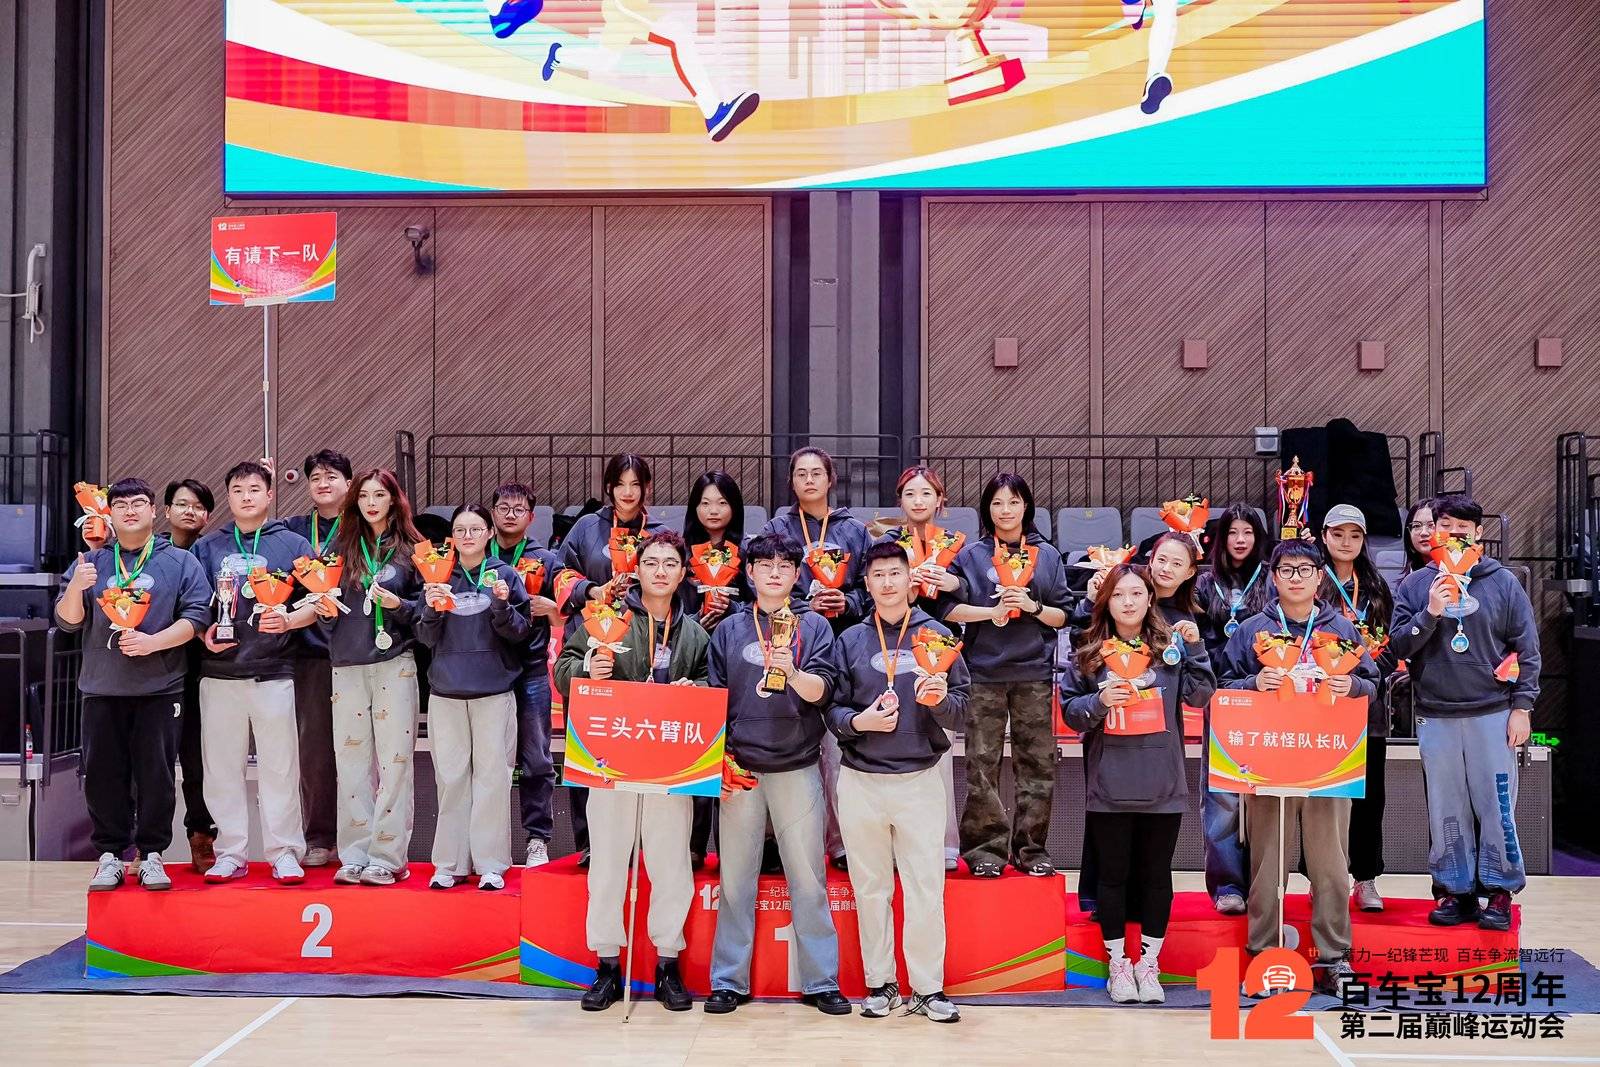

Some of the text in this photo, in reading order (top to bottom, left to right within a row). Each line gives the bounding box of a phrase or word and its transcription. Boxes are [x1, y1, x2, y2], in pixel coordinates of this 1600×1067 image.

[225, 243, 319, 265] 有请下一队
[577, 684, 589, 695] 12
[1218, 696, 1230, 705] 12
[587, 716, 704, 744] 三头六臂队
[1228, 730, 1348, 750] 输了就怪队长队
[301, 903, 332, 957] 2
[775, 921, 801, 992] 1
